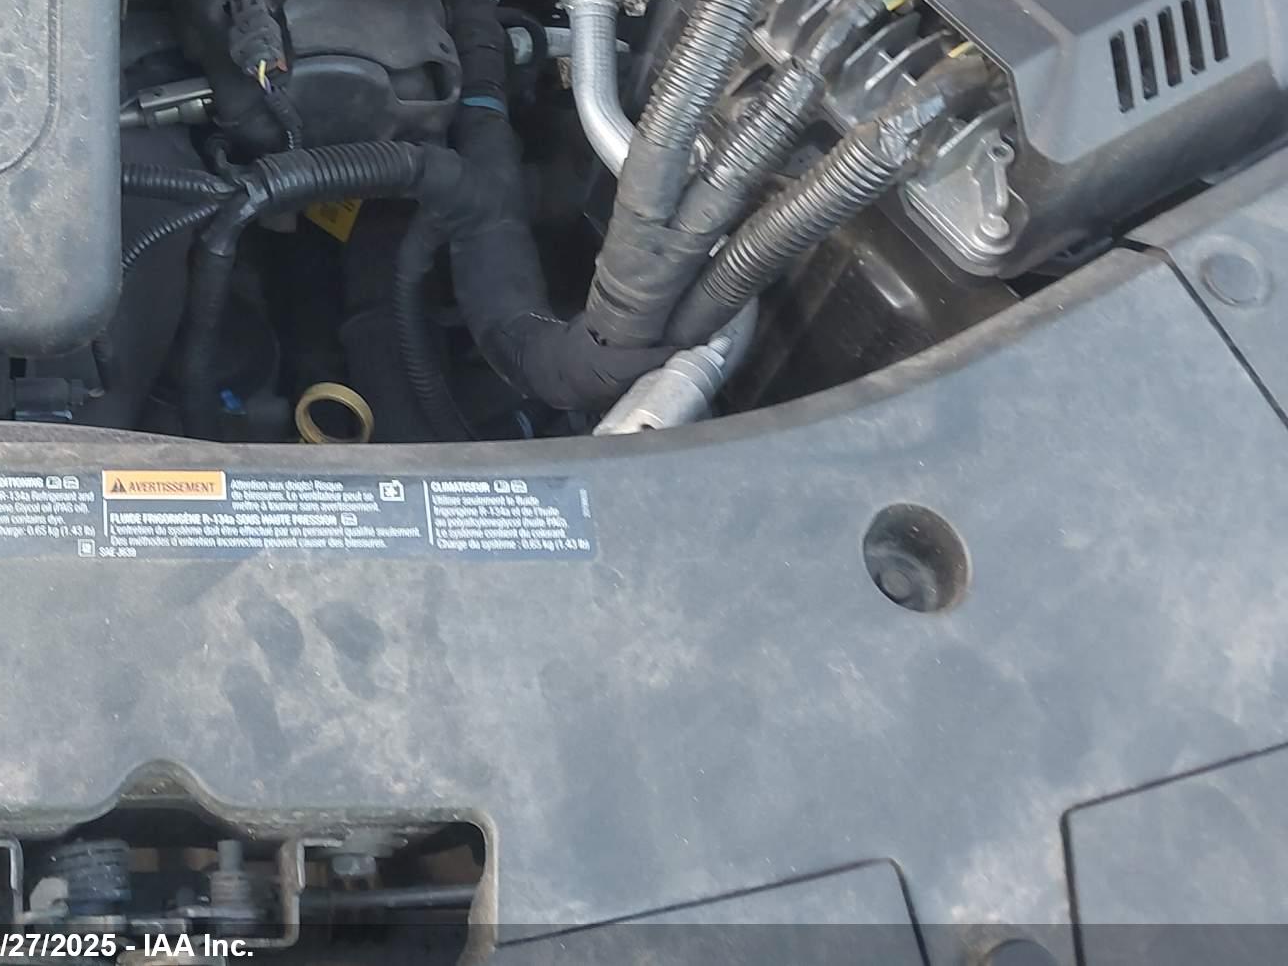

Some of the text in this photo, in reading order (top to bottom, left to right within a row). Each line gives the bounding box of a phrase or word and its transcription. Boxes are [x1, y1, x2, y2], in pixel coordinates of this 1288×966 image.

[129, 481, 214, 493] AVERTISSEMENT
[431, 481, 491, 493] CLIMATISEUR
[110, 513, 141, 524] FLUIDE
[236, 514, 261, 525] SOUS
[261, 514, 291, 525] HAUTE
[292, 514, 337, 526] PRESSION
